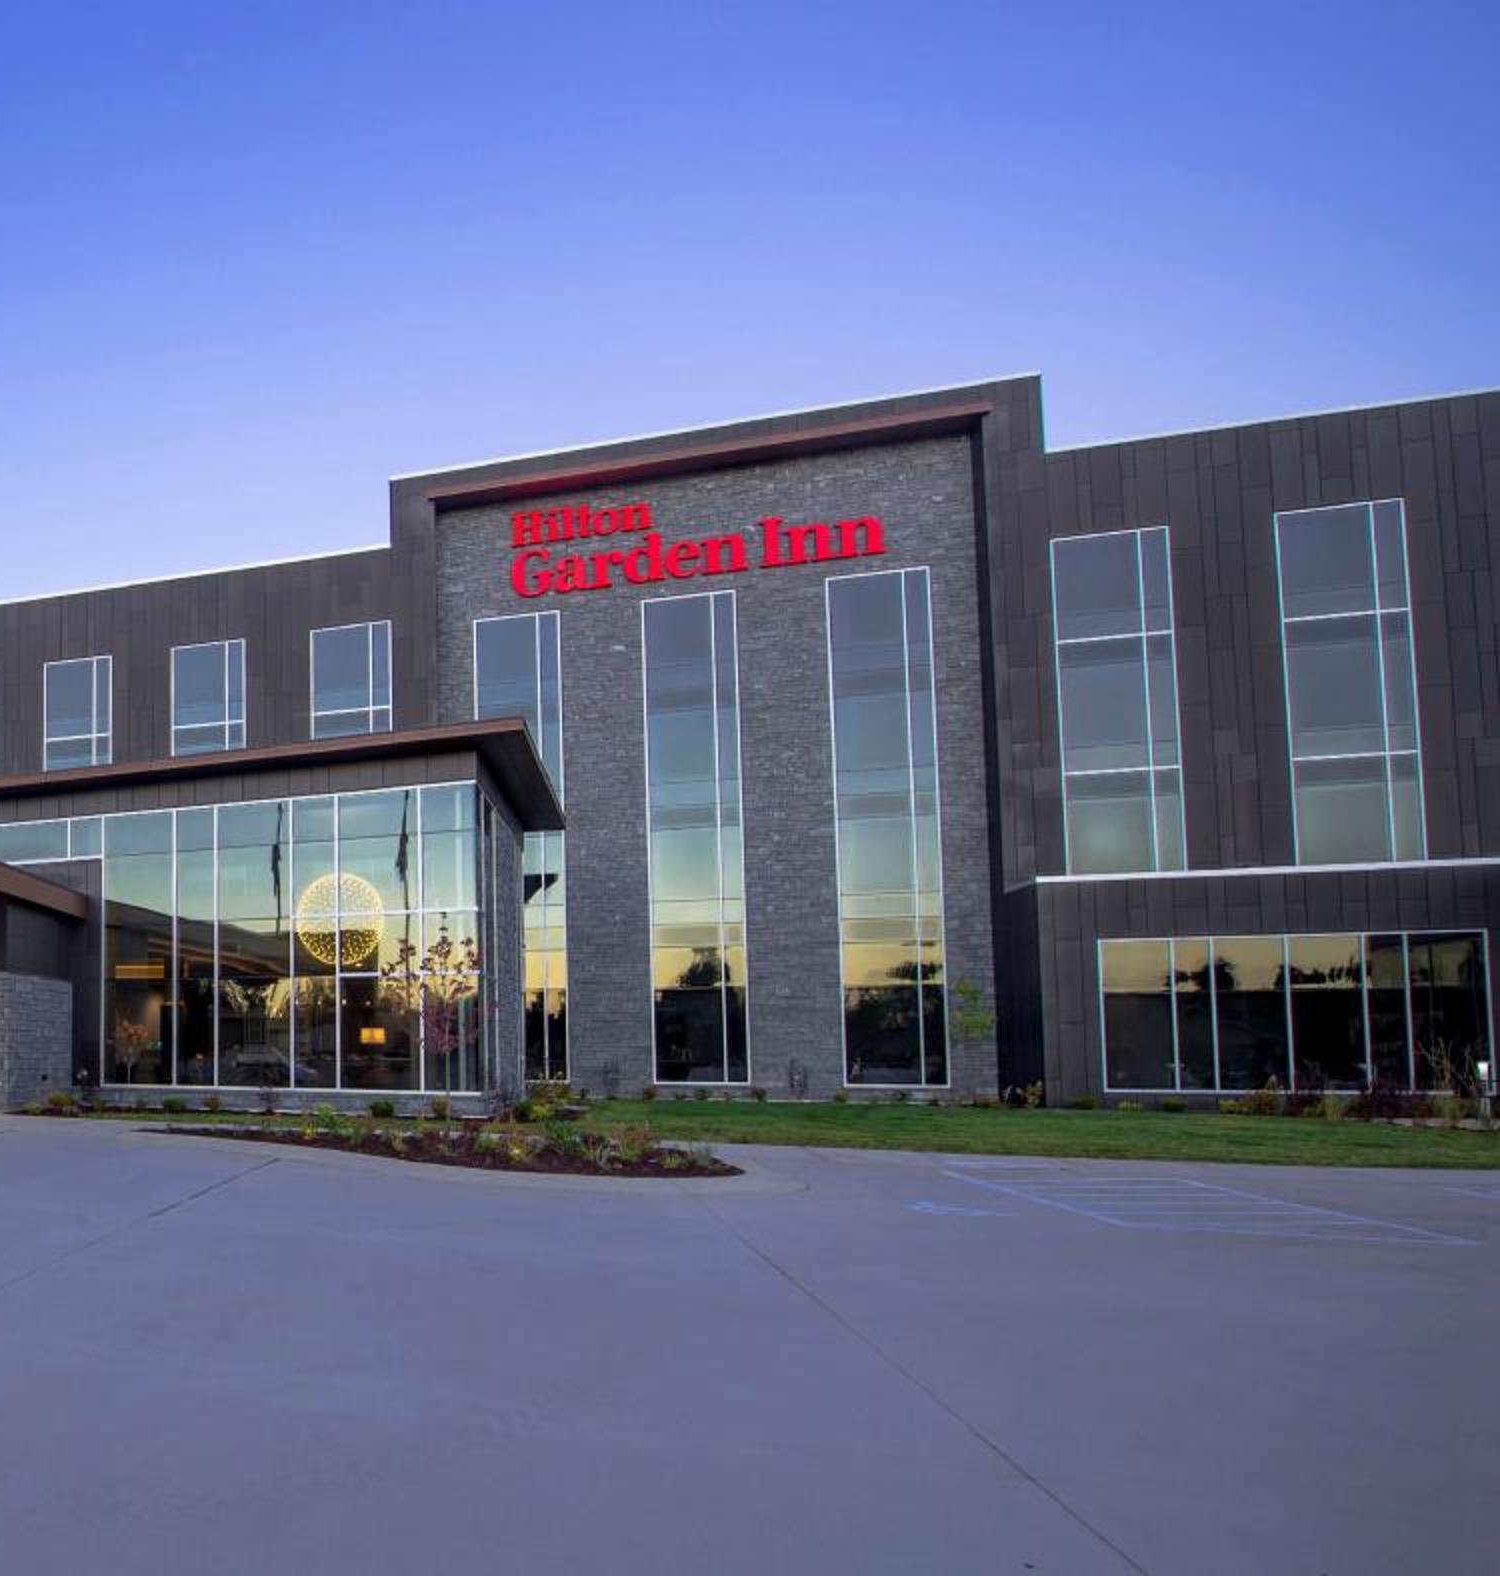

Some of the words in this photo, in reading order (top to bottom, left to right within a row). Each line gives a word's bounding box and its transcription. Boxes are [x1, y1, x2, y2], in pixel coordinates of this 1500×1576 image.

[510, 530, 749, 598] Garden
[760, 515, 886, 569] Inn
[511, 501, 652, 548] Hilton
